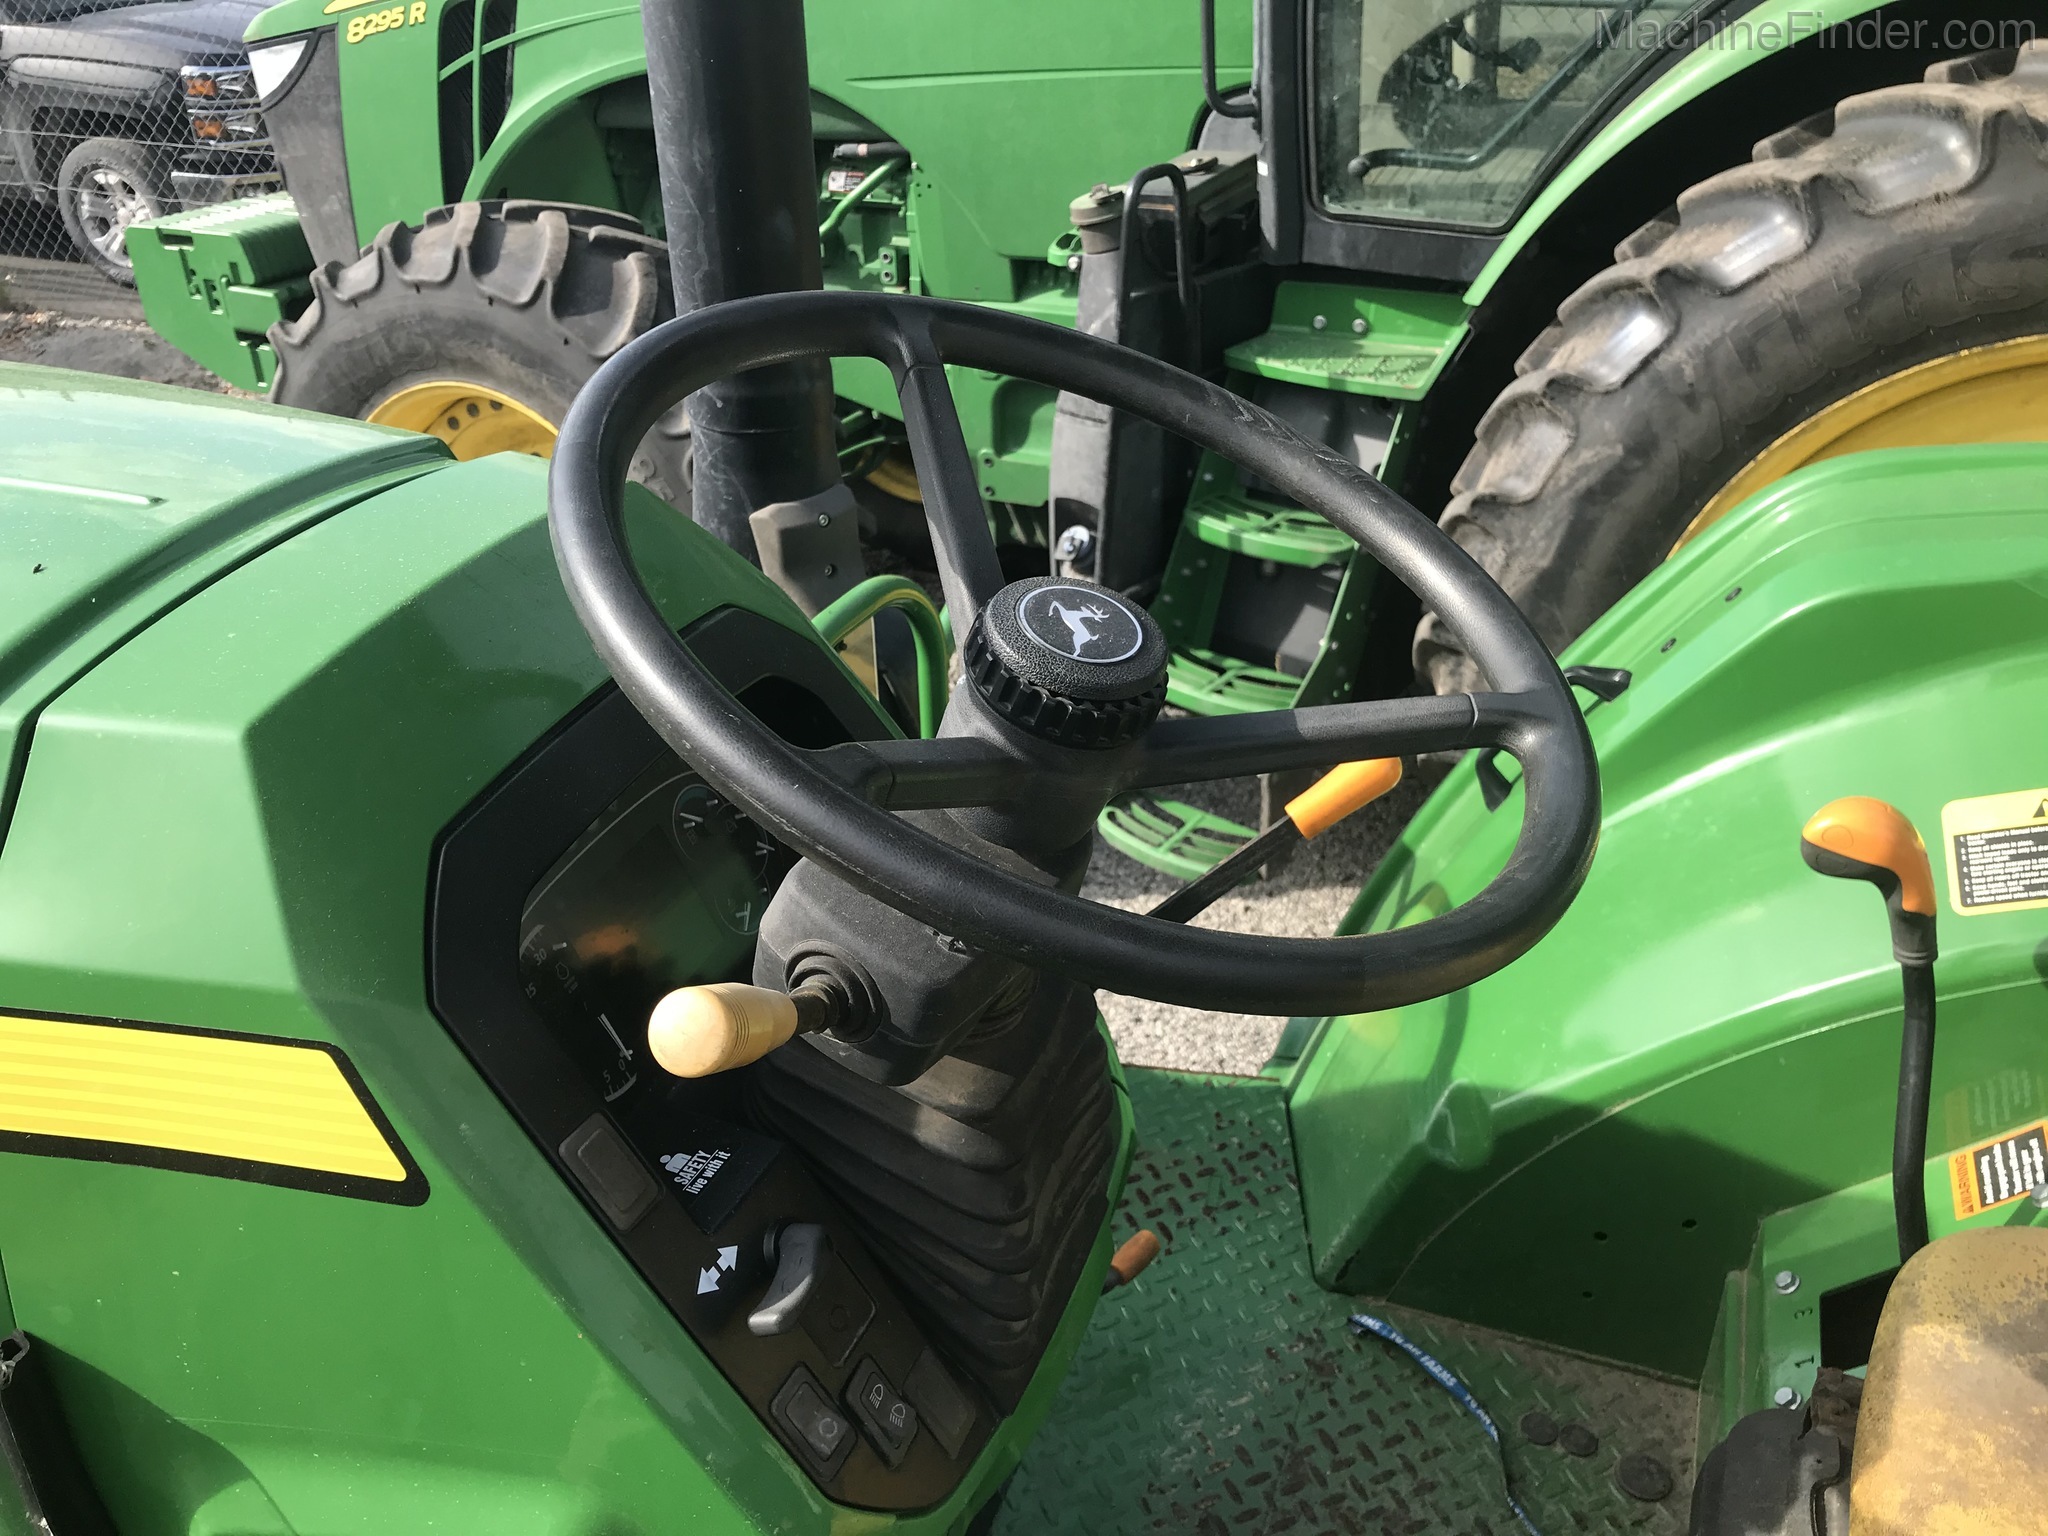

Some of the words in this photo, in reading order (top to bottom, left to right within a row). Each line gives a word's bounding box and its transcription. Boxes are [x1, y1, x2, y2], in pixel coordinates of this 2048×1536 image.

[346, 6, 405, 45] 8295
[408, 1, 427, 26] R
[674, 1150, 711, 1185] SAFETY
[686, 1178, 708, 1194] live
[702, 1159, 724, 1178] with
[715, 1151, 731, 1160] it
[1955, 1153, 1973, 1206] WARNING
